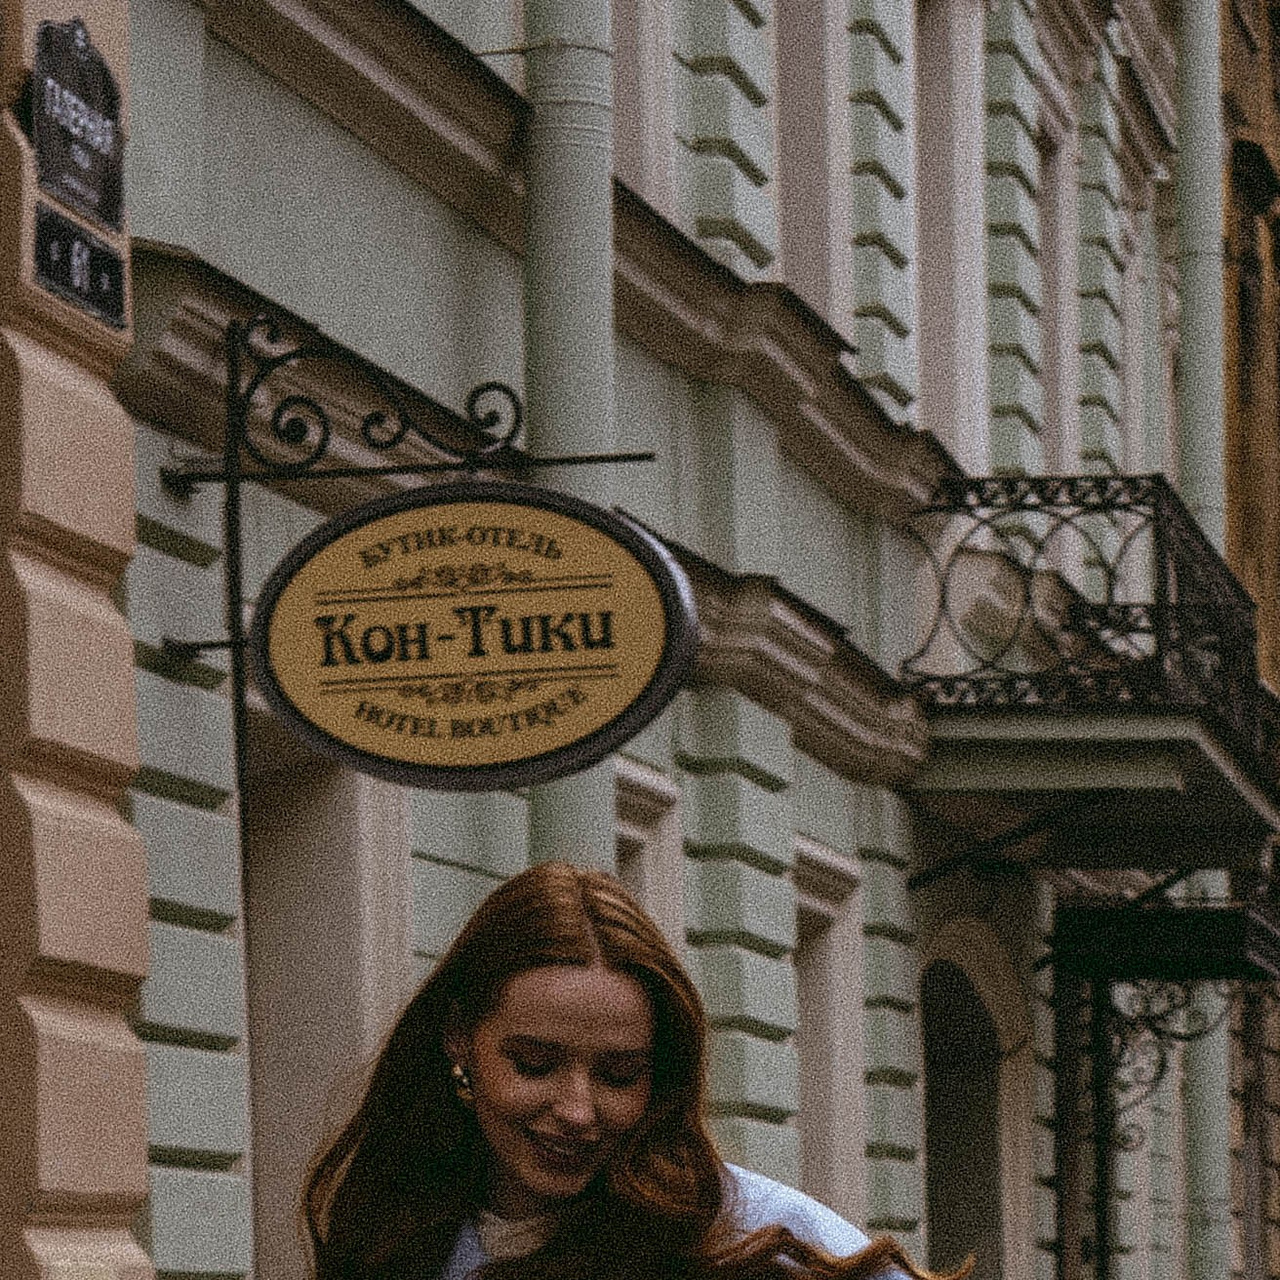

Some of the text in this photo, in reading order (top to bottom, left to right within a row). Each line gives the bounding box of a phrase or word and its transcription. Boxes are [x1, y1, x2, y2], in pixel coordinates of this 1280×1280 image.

[359, 525, 562, 568] БУТИК-ОТЕЛЬ
[315, 605, 614, 666] Кон-Тики
[354, 688, 588, 738] HOTEL BOUTIQUE
